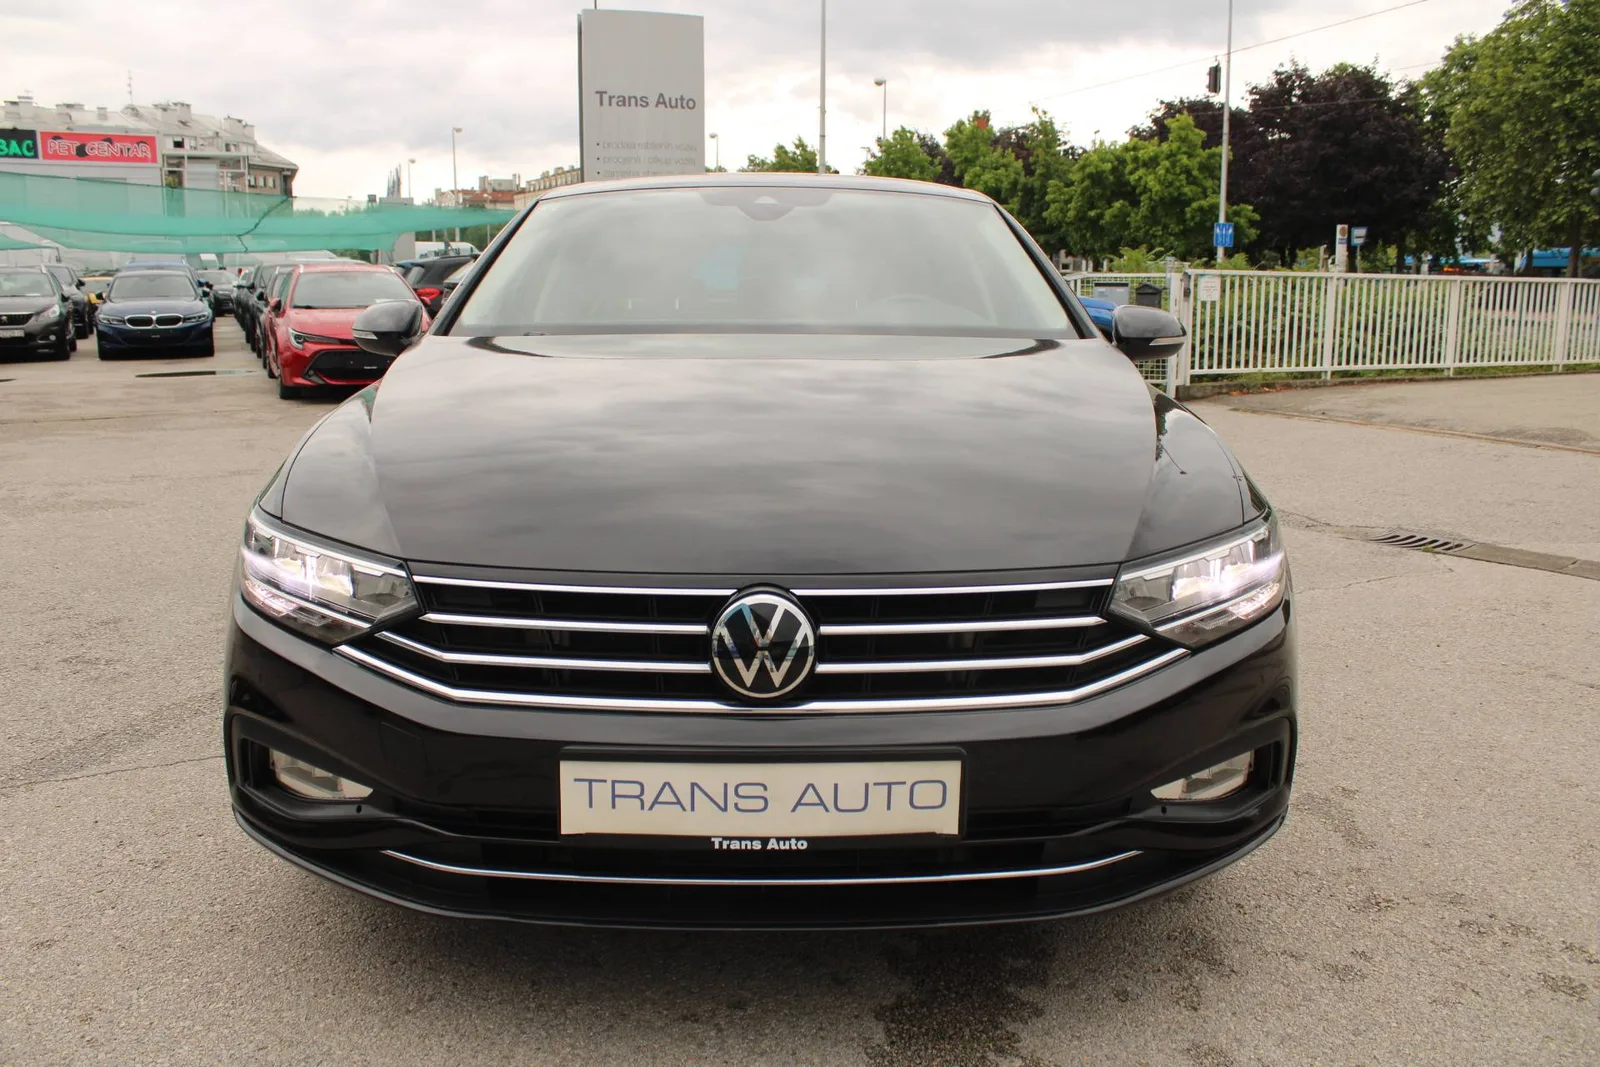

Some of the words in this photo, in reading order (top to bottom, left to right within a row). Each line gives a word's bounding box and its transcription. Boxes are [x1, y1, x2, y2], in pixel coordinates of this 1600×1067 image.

[595, 91, 650, 108] Trans
[655, 92, 696, 110] Auto
[47, 139, 79, 156] PET
[85, 140, 152, 158] CENTAR
[573, 777, 769, 813] TRANS
[790, 778, 948, 813] AUTO
[710, 837, 762, 851] Trans
[766, 837, 808, 851] Auto
